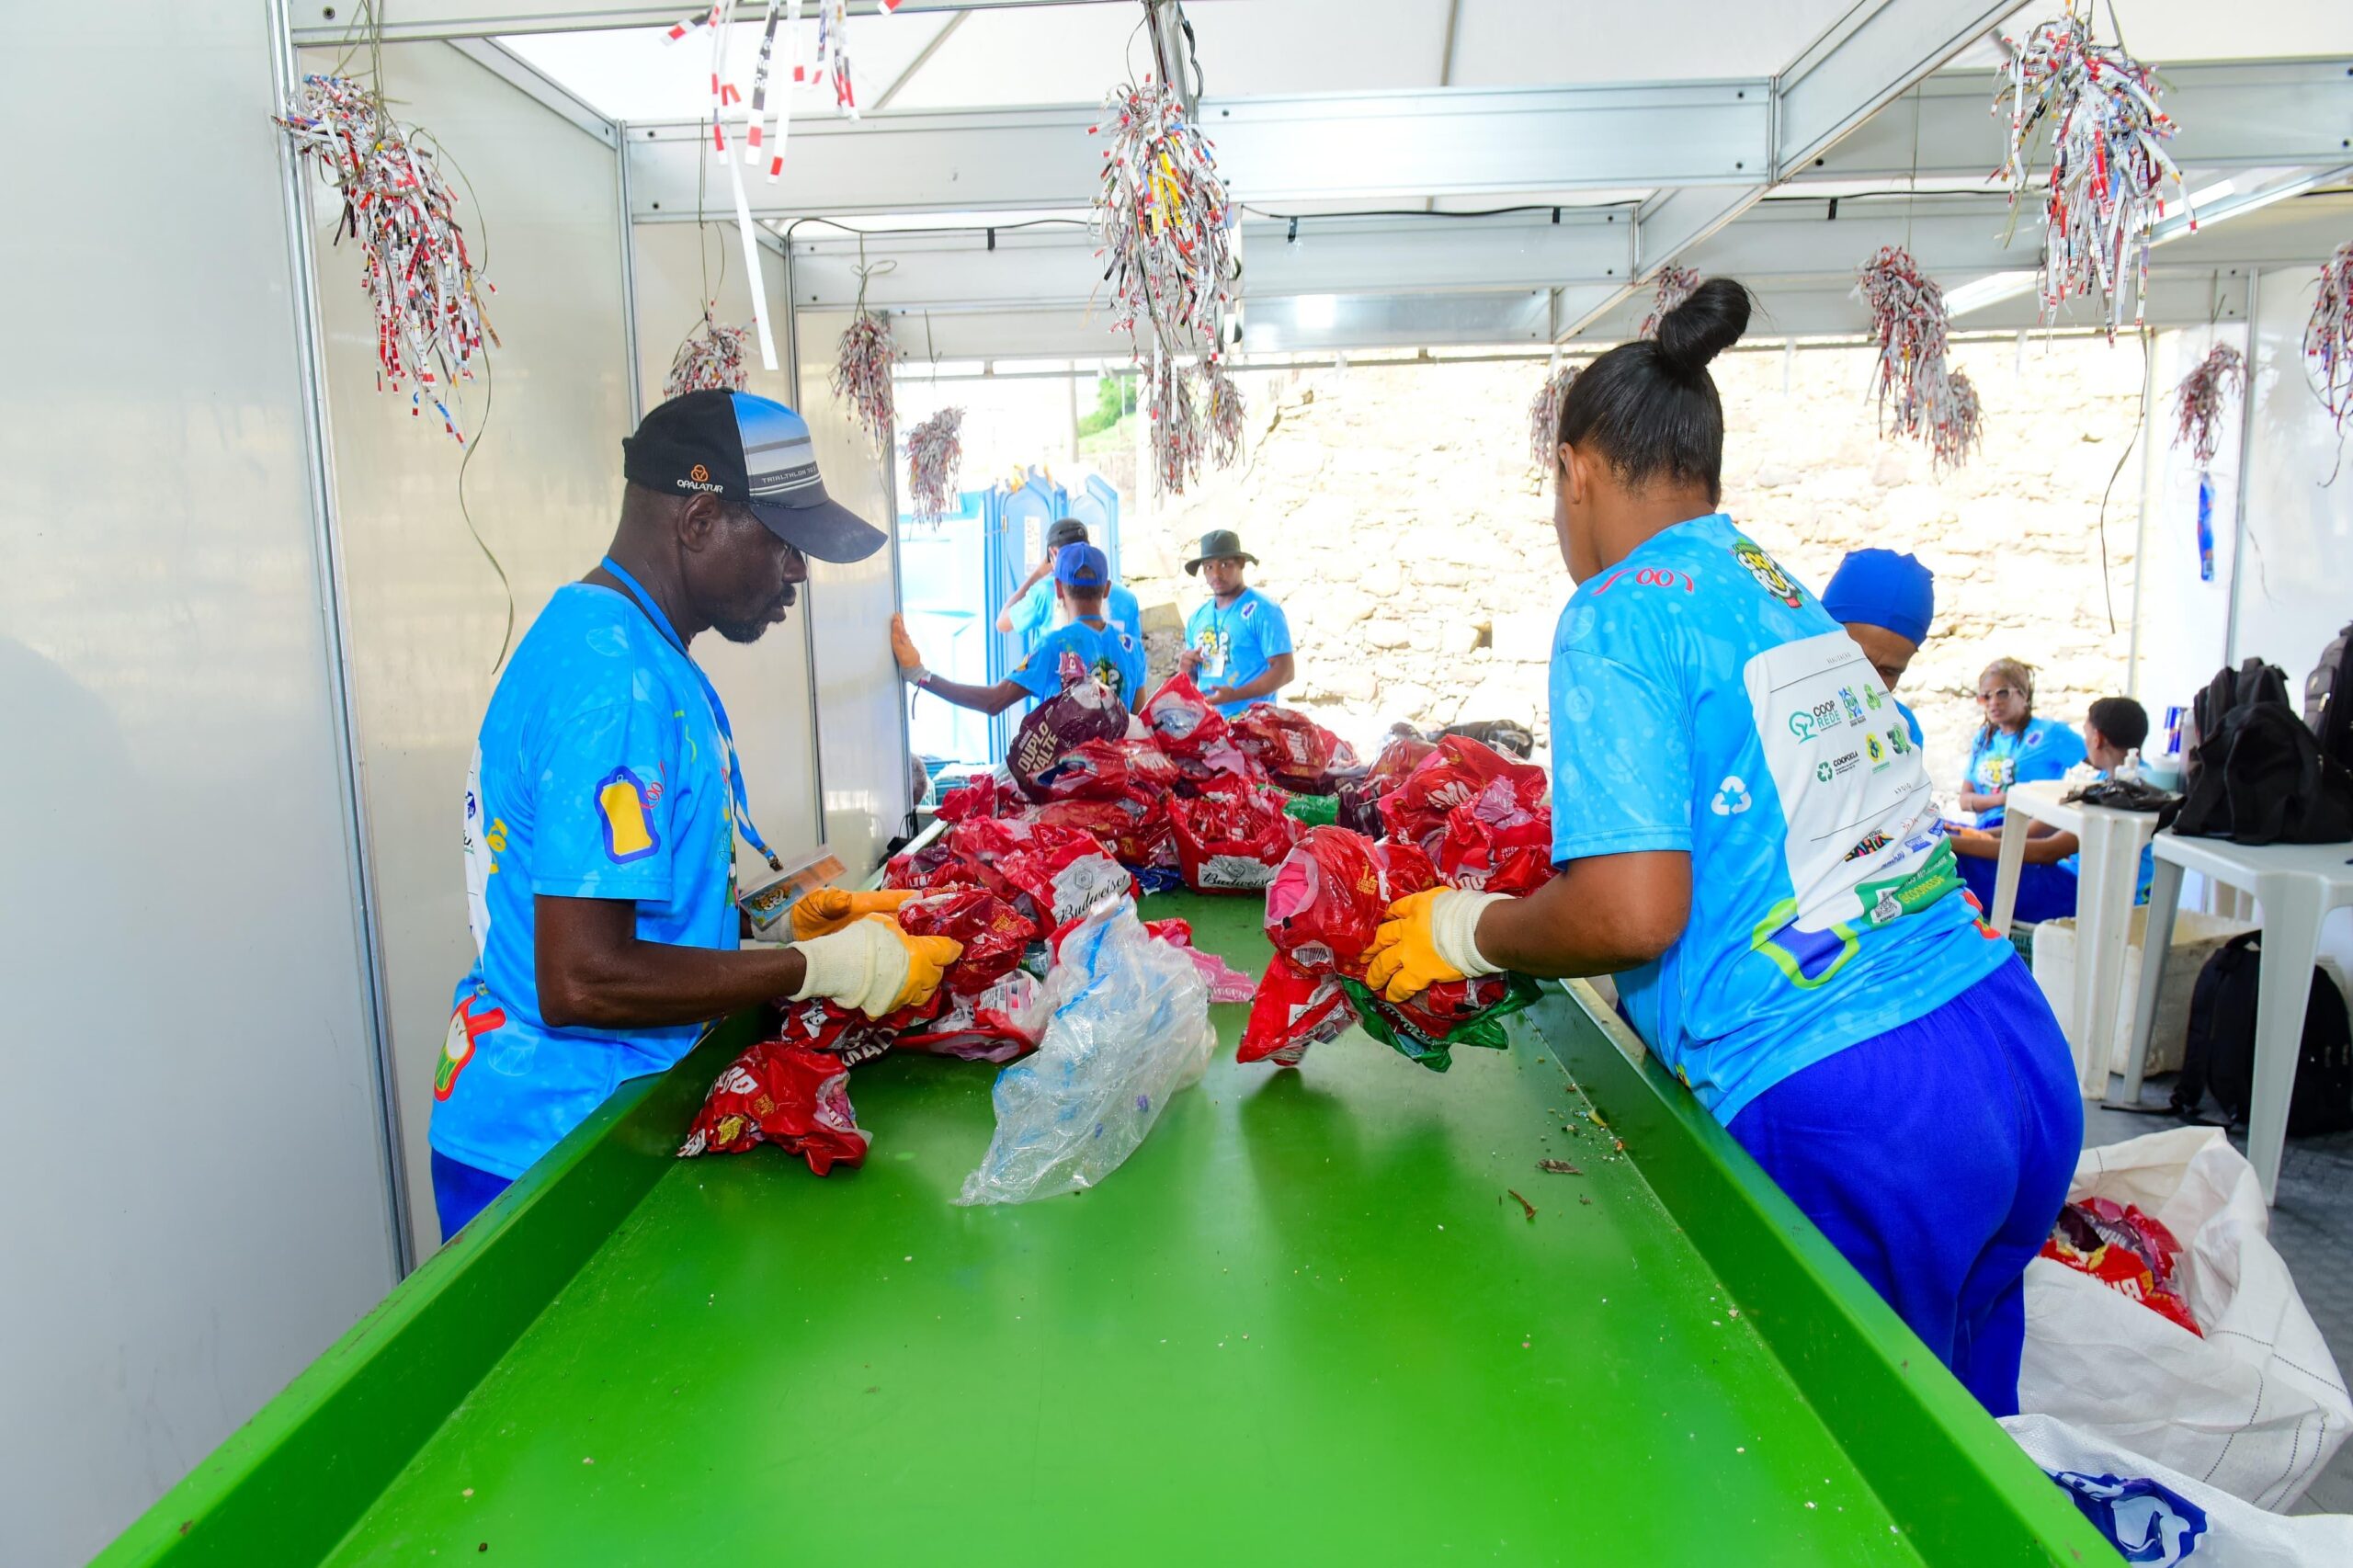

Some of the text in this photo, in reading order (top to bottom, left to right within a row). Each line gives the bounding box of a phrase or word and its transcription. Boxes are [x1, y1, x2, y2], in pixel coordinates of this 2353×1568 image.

[676, 479, 723, 494] OPALATUR
[1813, 699, 1836, 717] COOP
[1816, 710, 1841, 729] REDE
[1017, 722, 1049, 773] DUPLO
[1054, 874, 1127, 926] Budweiser
